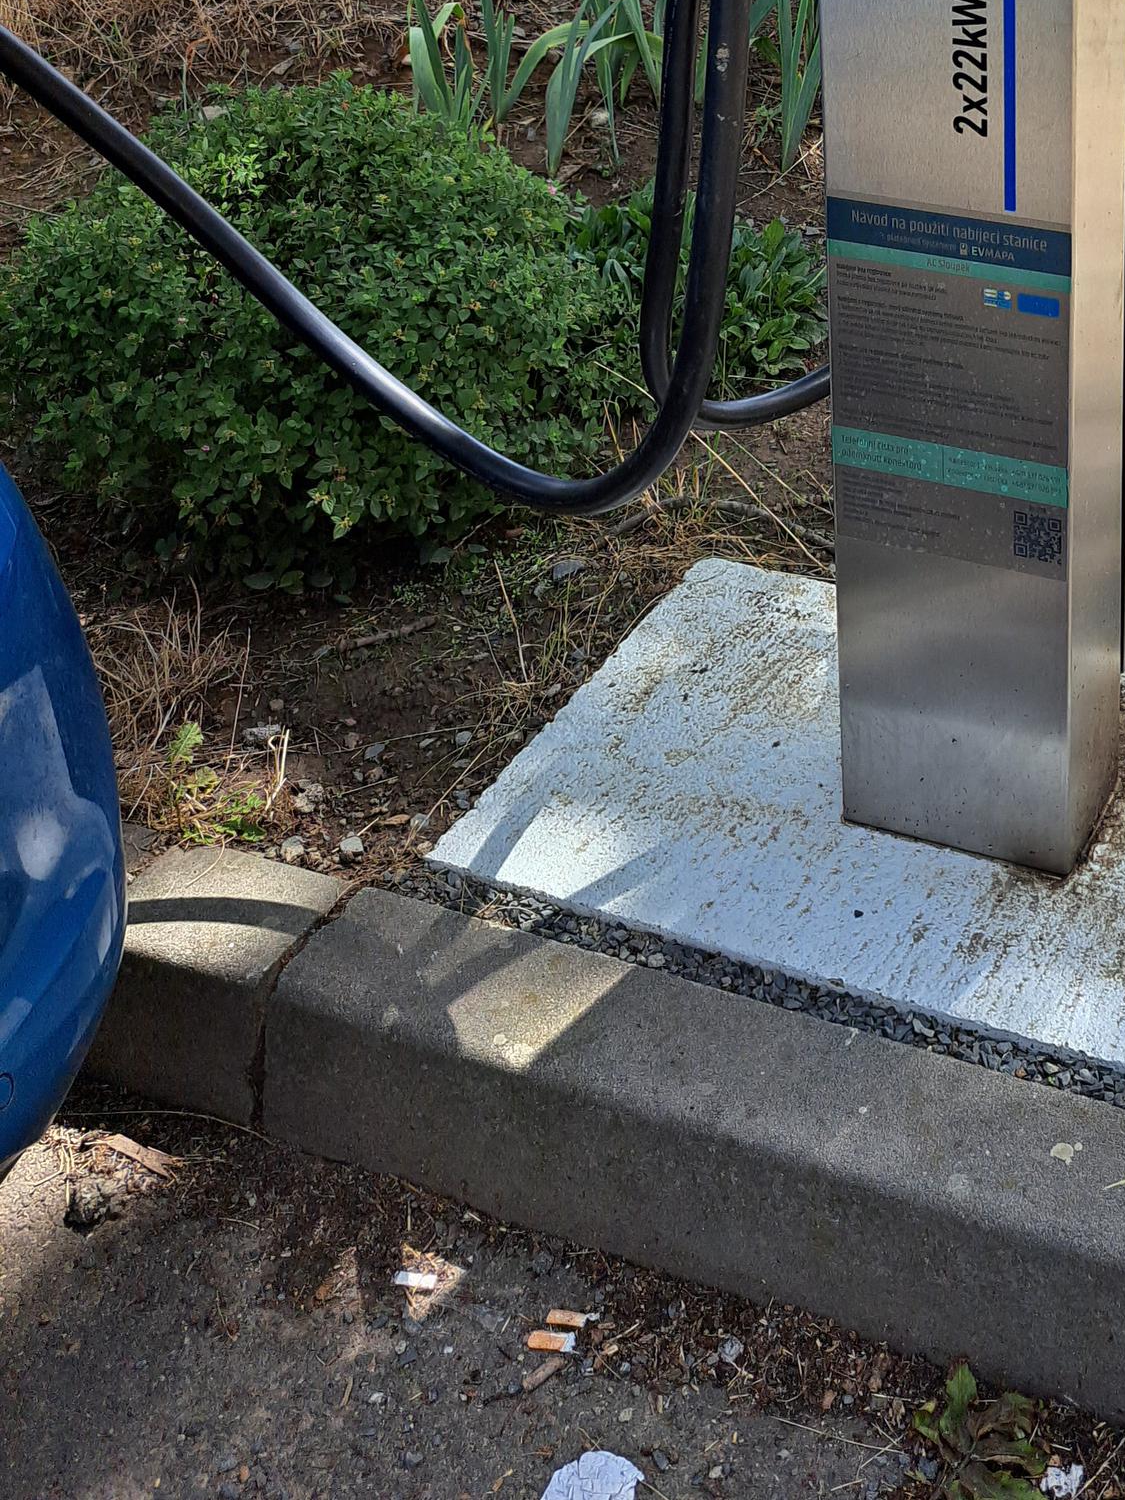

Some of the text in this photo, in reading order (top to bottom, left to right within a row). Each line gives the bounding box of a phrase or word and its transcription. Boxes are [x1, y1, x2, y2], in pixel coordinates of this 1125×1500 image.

[891, 216, 906, 230] na
[1002, 231, 1048, 252] stanice
[971, 245, 1016, 262] EVMAPA
